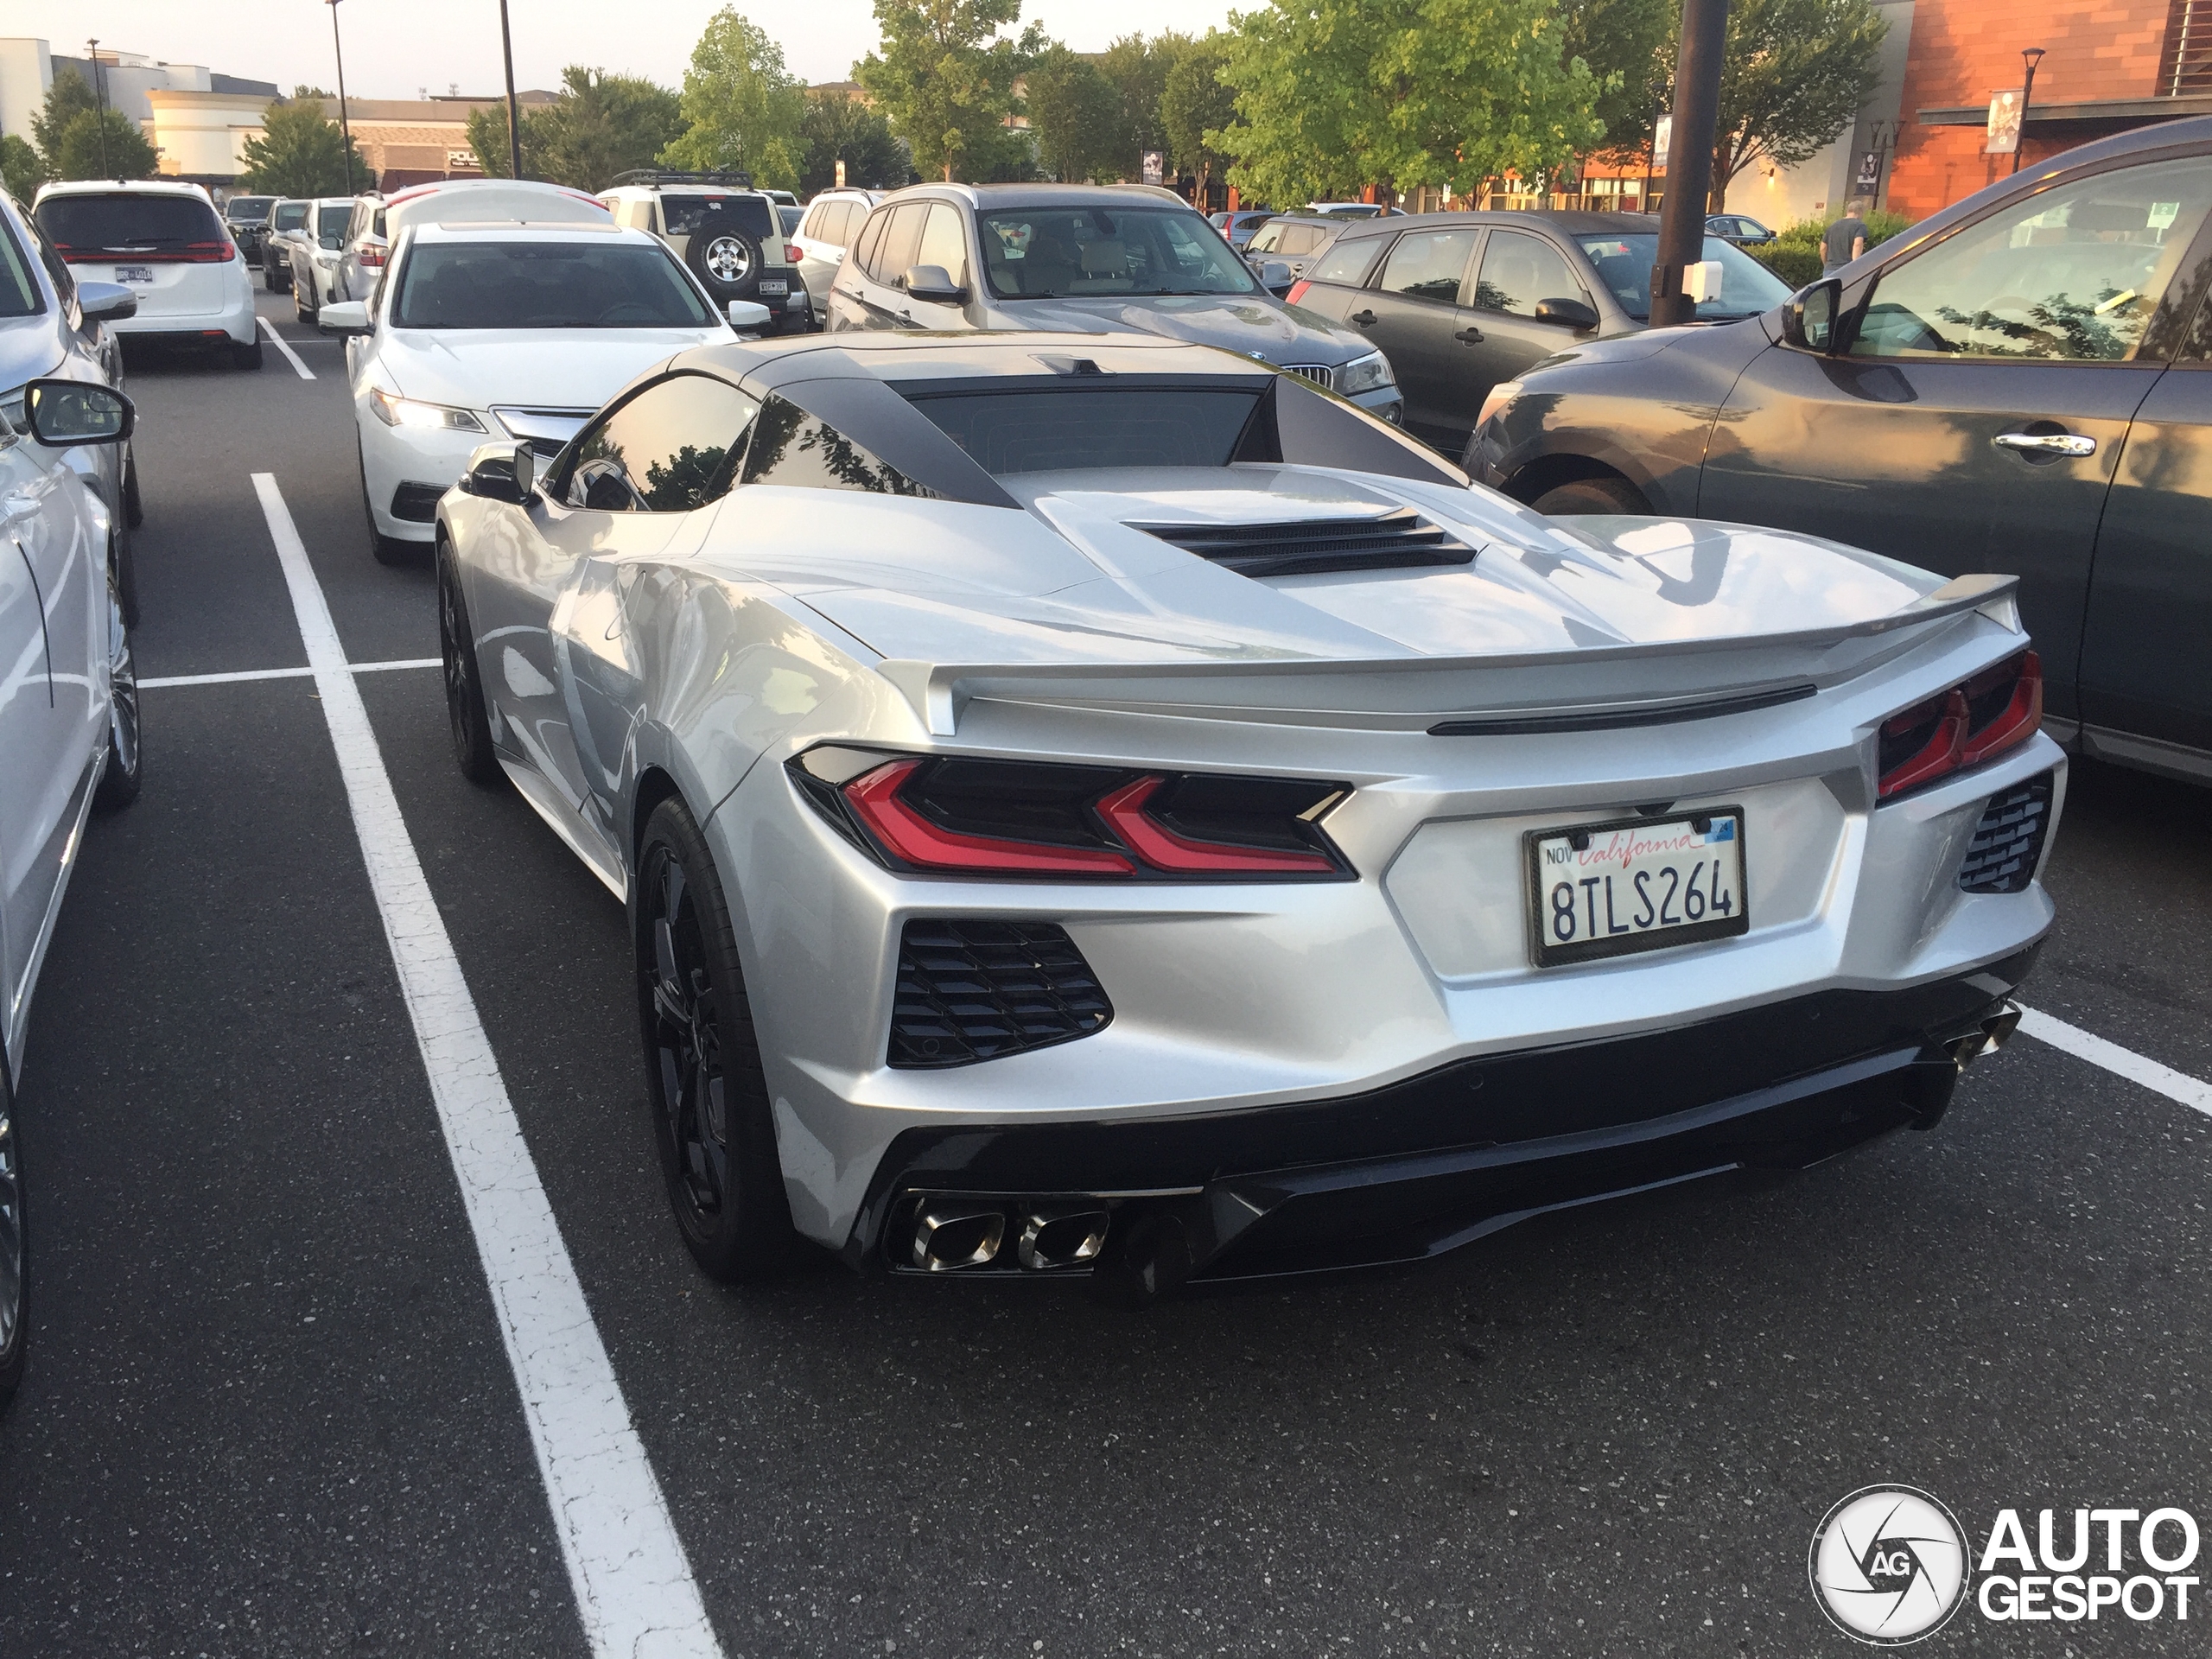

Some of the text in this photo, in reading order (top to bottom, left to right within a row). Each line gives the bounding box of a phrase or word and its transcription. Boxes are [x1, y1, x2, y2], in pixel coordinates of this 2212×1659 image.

[1546, 830, 1706, 869] NOV California
[1551, 859, 1732, 942] 8TLS264
